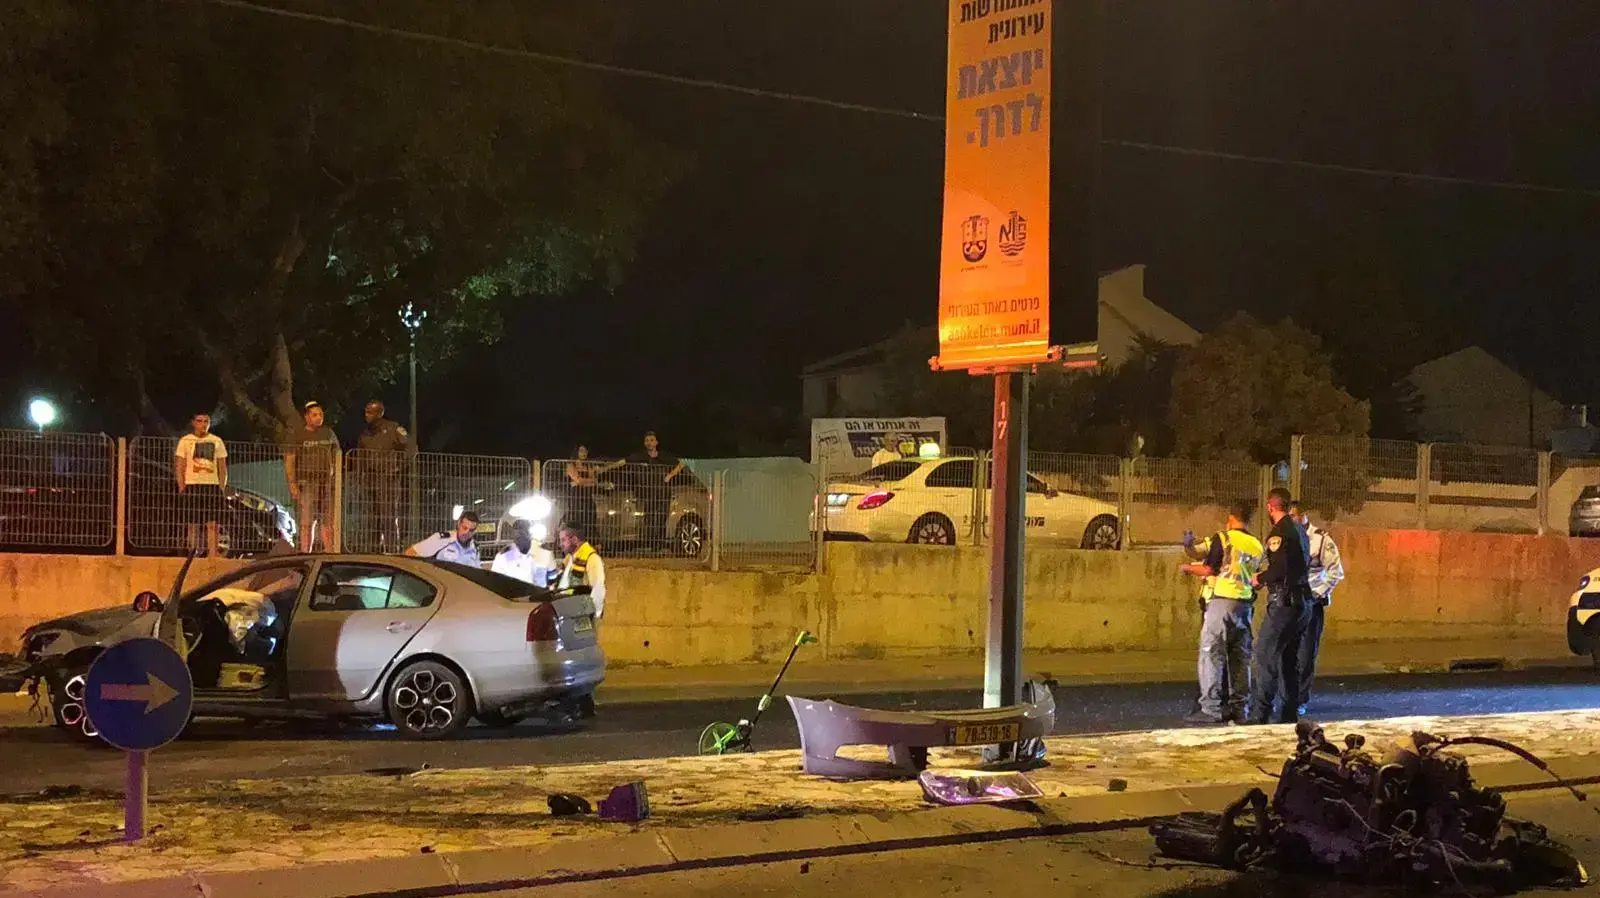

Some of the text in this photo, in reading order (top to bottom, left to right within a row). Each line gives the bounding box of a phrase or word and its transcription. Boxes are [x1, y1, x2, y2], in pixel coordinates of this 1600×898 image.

[988, 12, 1044, 43] עירונית
[958, 48, 1044, 100] יוצאת
[966, 92, 1042, 148] לדרך.
[982, 300, 1008, 315] באתר
[1010, 296, 1040, 313] פרטים
[845, 420, 920, 431] זה אנחנו או הם
